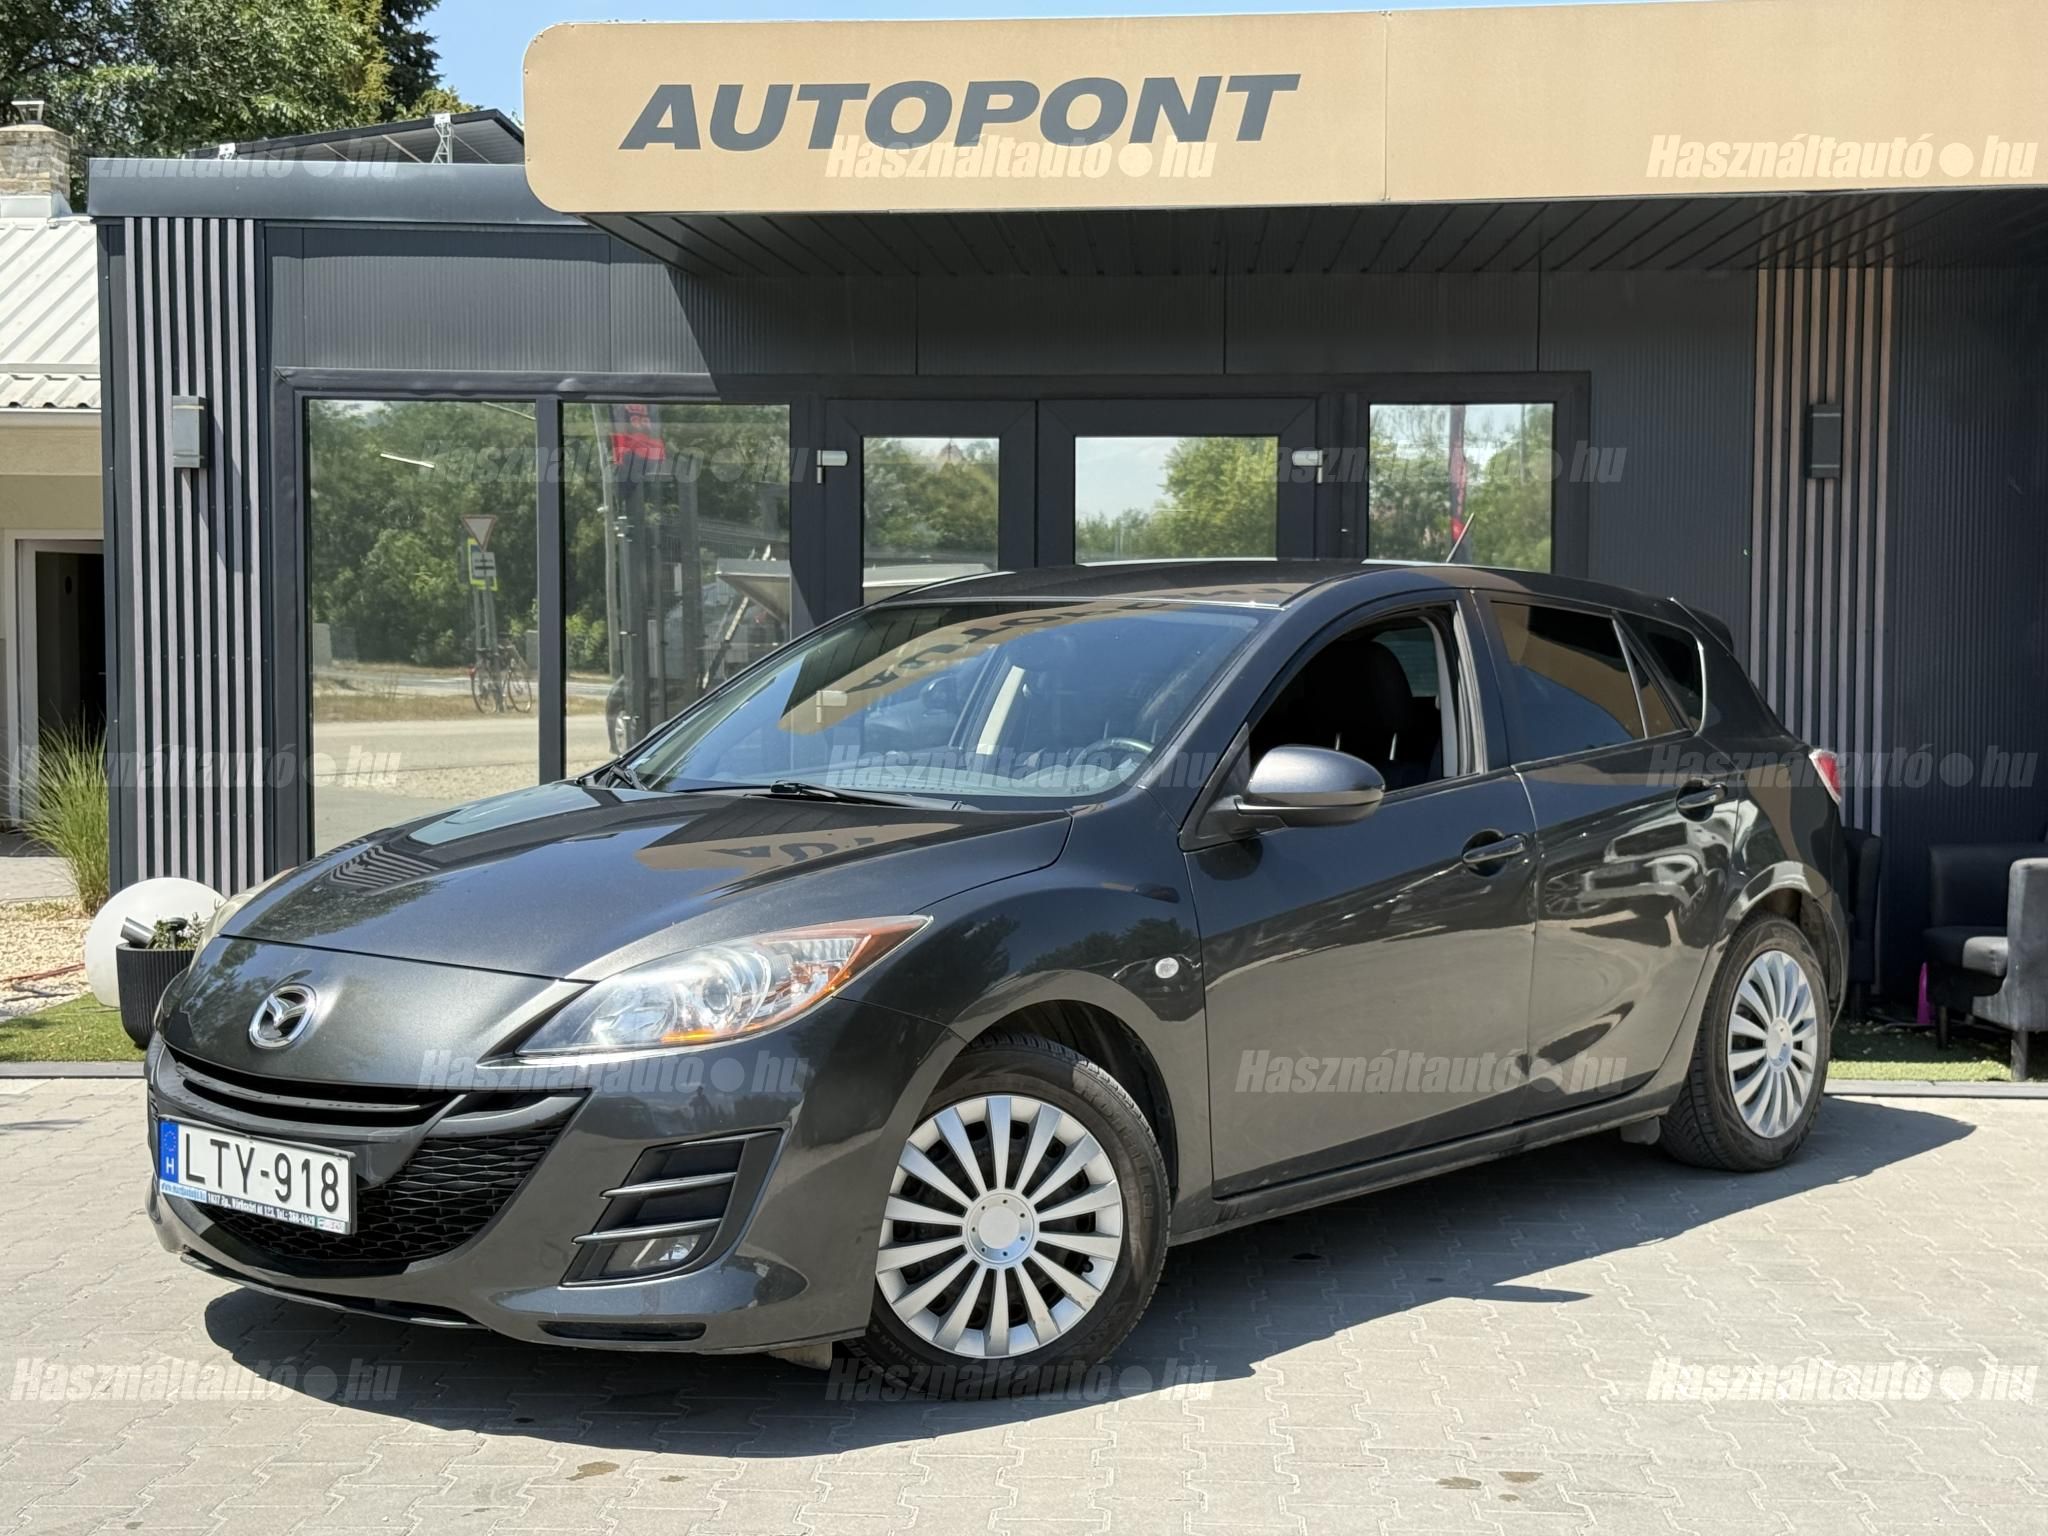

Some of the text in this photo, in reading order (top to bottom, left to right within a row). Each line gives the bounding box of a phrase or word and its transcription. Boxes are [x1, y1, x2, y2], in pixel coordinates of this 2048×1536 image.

[618, 74, 1301, 151] AUTOPONT
[165, 1156, 175, 1175] H
[185, 1132, 339, 1213] LTY-918
